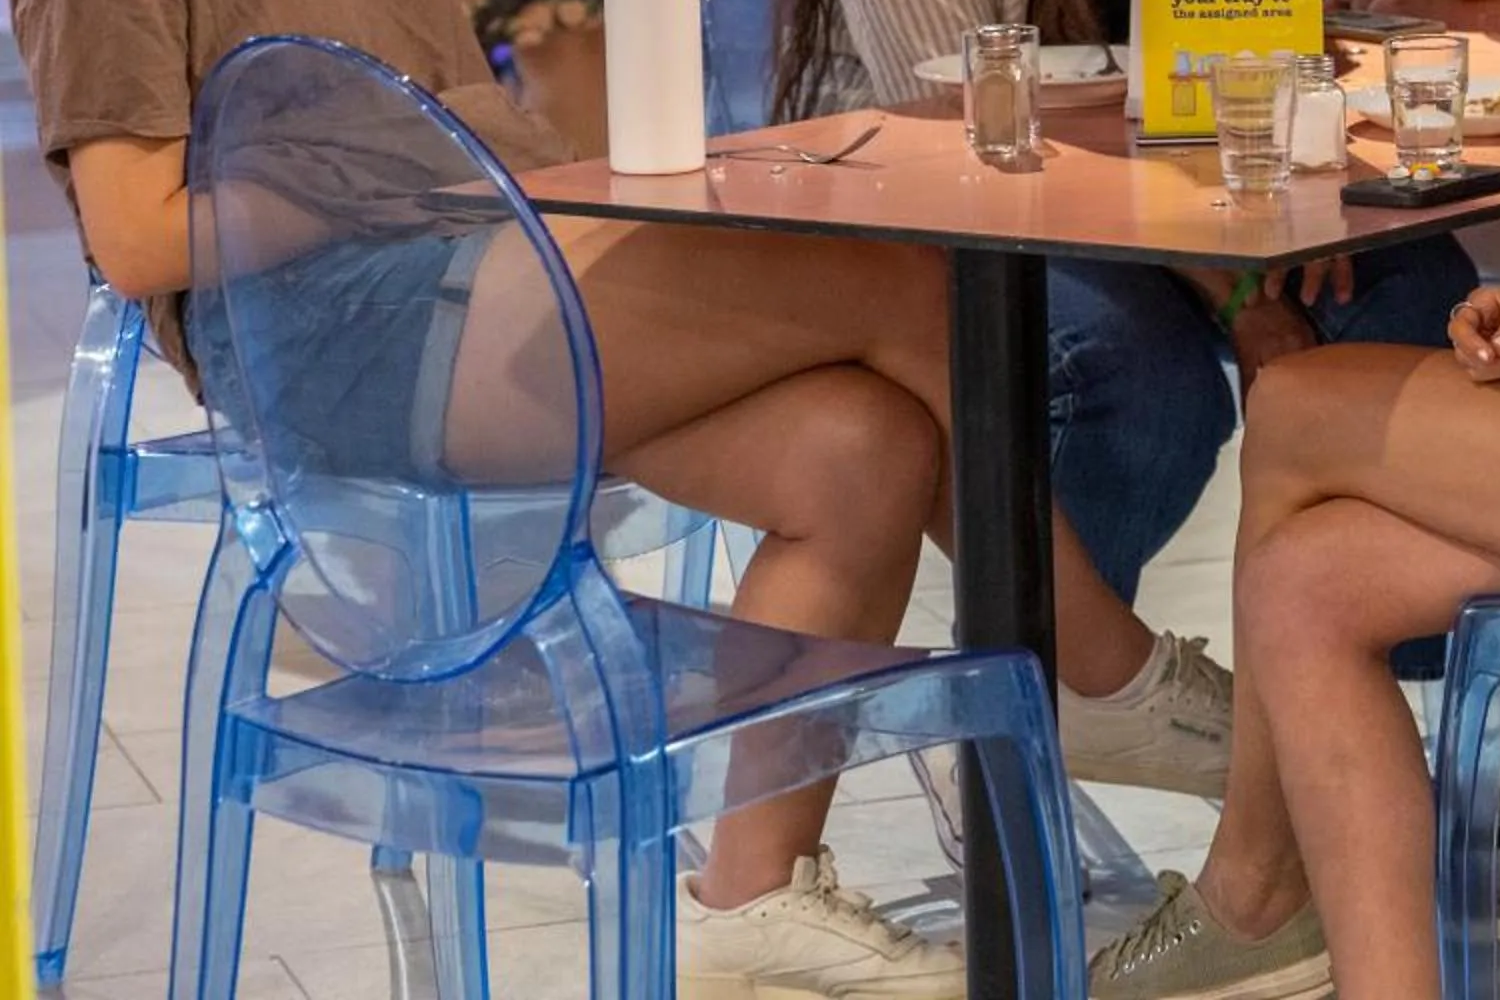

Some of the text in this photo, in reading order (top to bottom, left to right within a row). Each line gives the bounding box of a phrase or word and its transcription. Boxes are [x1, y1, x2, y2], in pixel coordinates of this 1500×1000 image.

[1172, 7, 1292, 20] the assigned area
